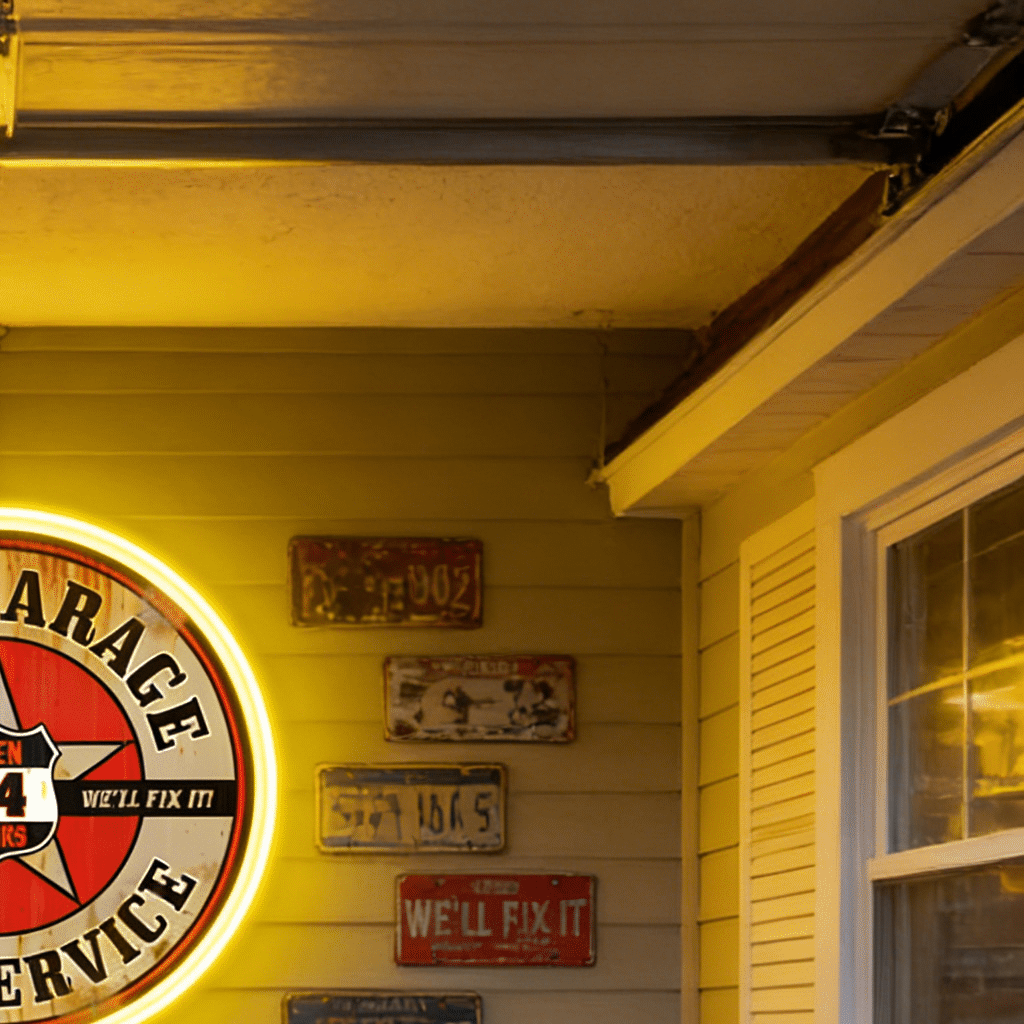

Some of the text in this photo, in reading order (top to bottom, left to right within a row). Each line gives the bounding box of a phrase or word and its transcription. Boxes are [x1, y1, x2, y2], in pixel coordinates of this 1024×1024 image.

[81, 788, 140, 809] WE'LL
[145, 788, 182, 809] FIX
[404, 896, 588, 939] WE'LL FIX IT
